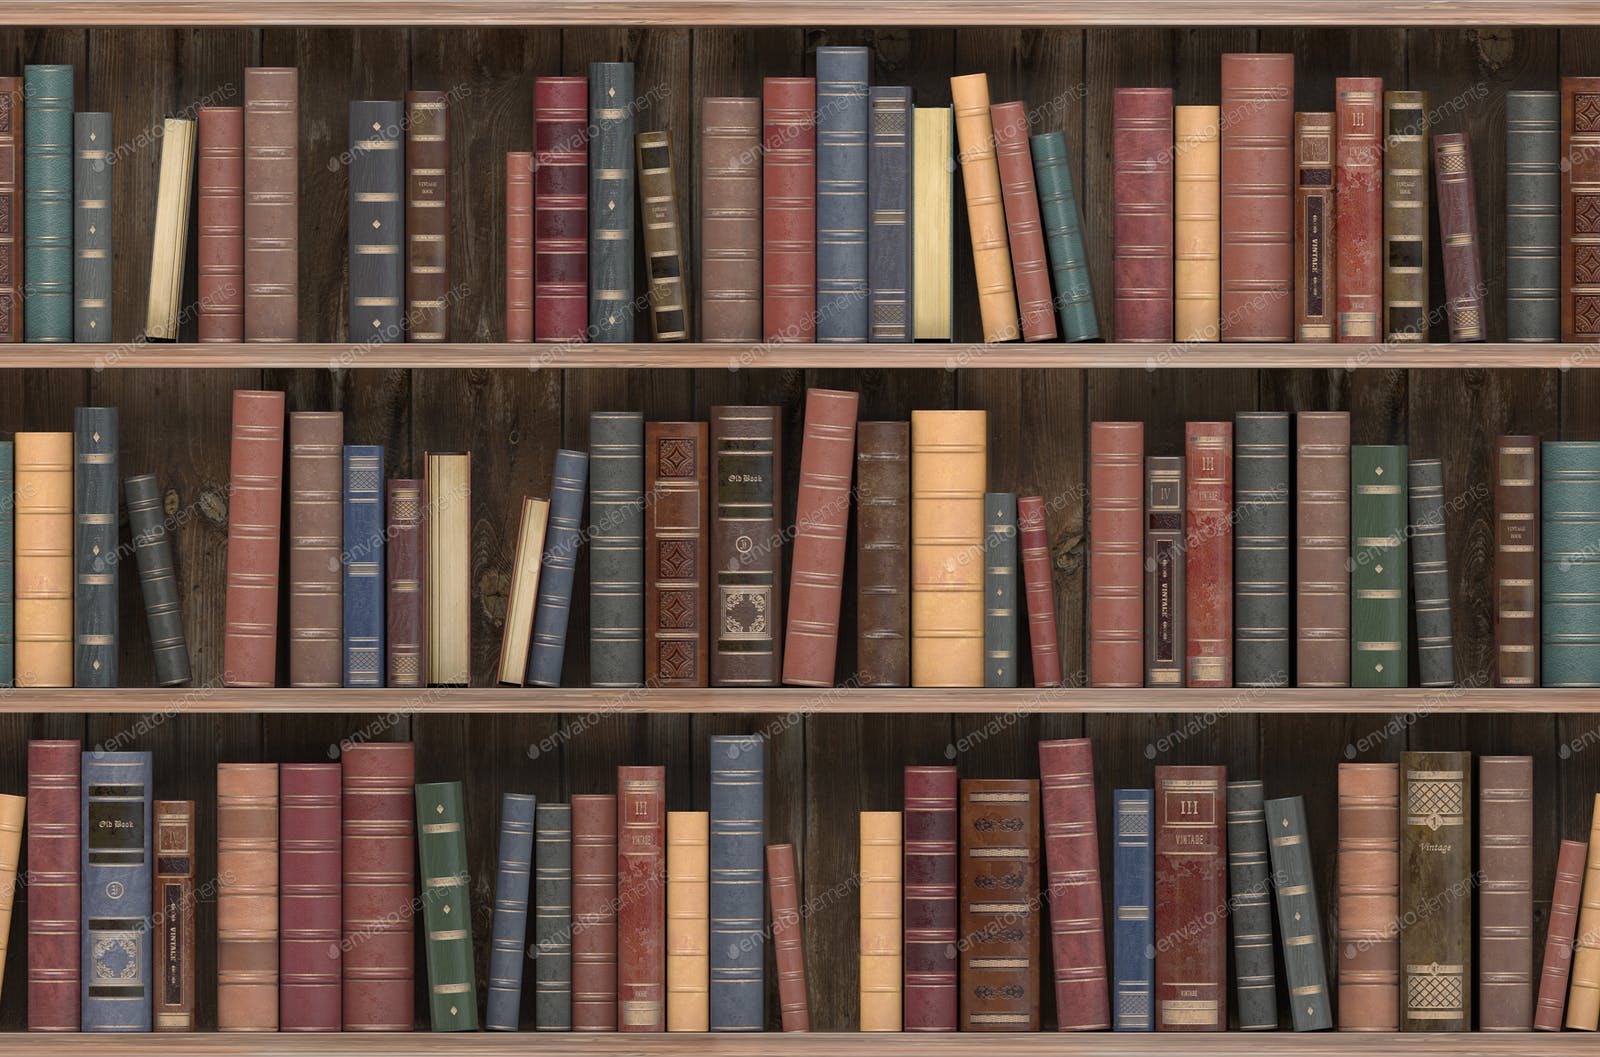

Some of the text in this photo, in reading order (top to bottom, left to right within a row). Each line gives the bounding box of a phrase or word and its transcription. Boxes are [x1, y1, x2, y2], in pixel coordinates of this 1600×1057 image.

[1352, 112, 1364, 127] III
[728, 474, 763, 482] Old Book
[1161, 487, 1171, 500] IV
[635, 801, 647, 815] III
[1180, 800, 1198, 815] III
[99, 820, 134, 828] Old Book
[1175, 834, 1204, 845] VINTAGE
[1419, 842, 1452, 854] Vintage
